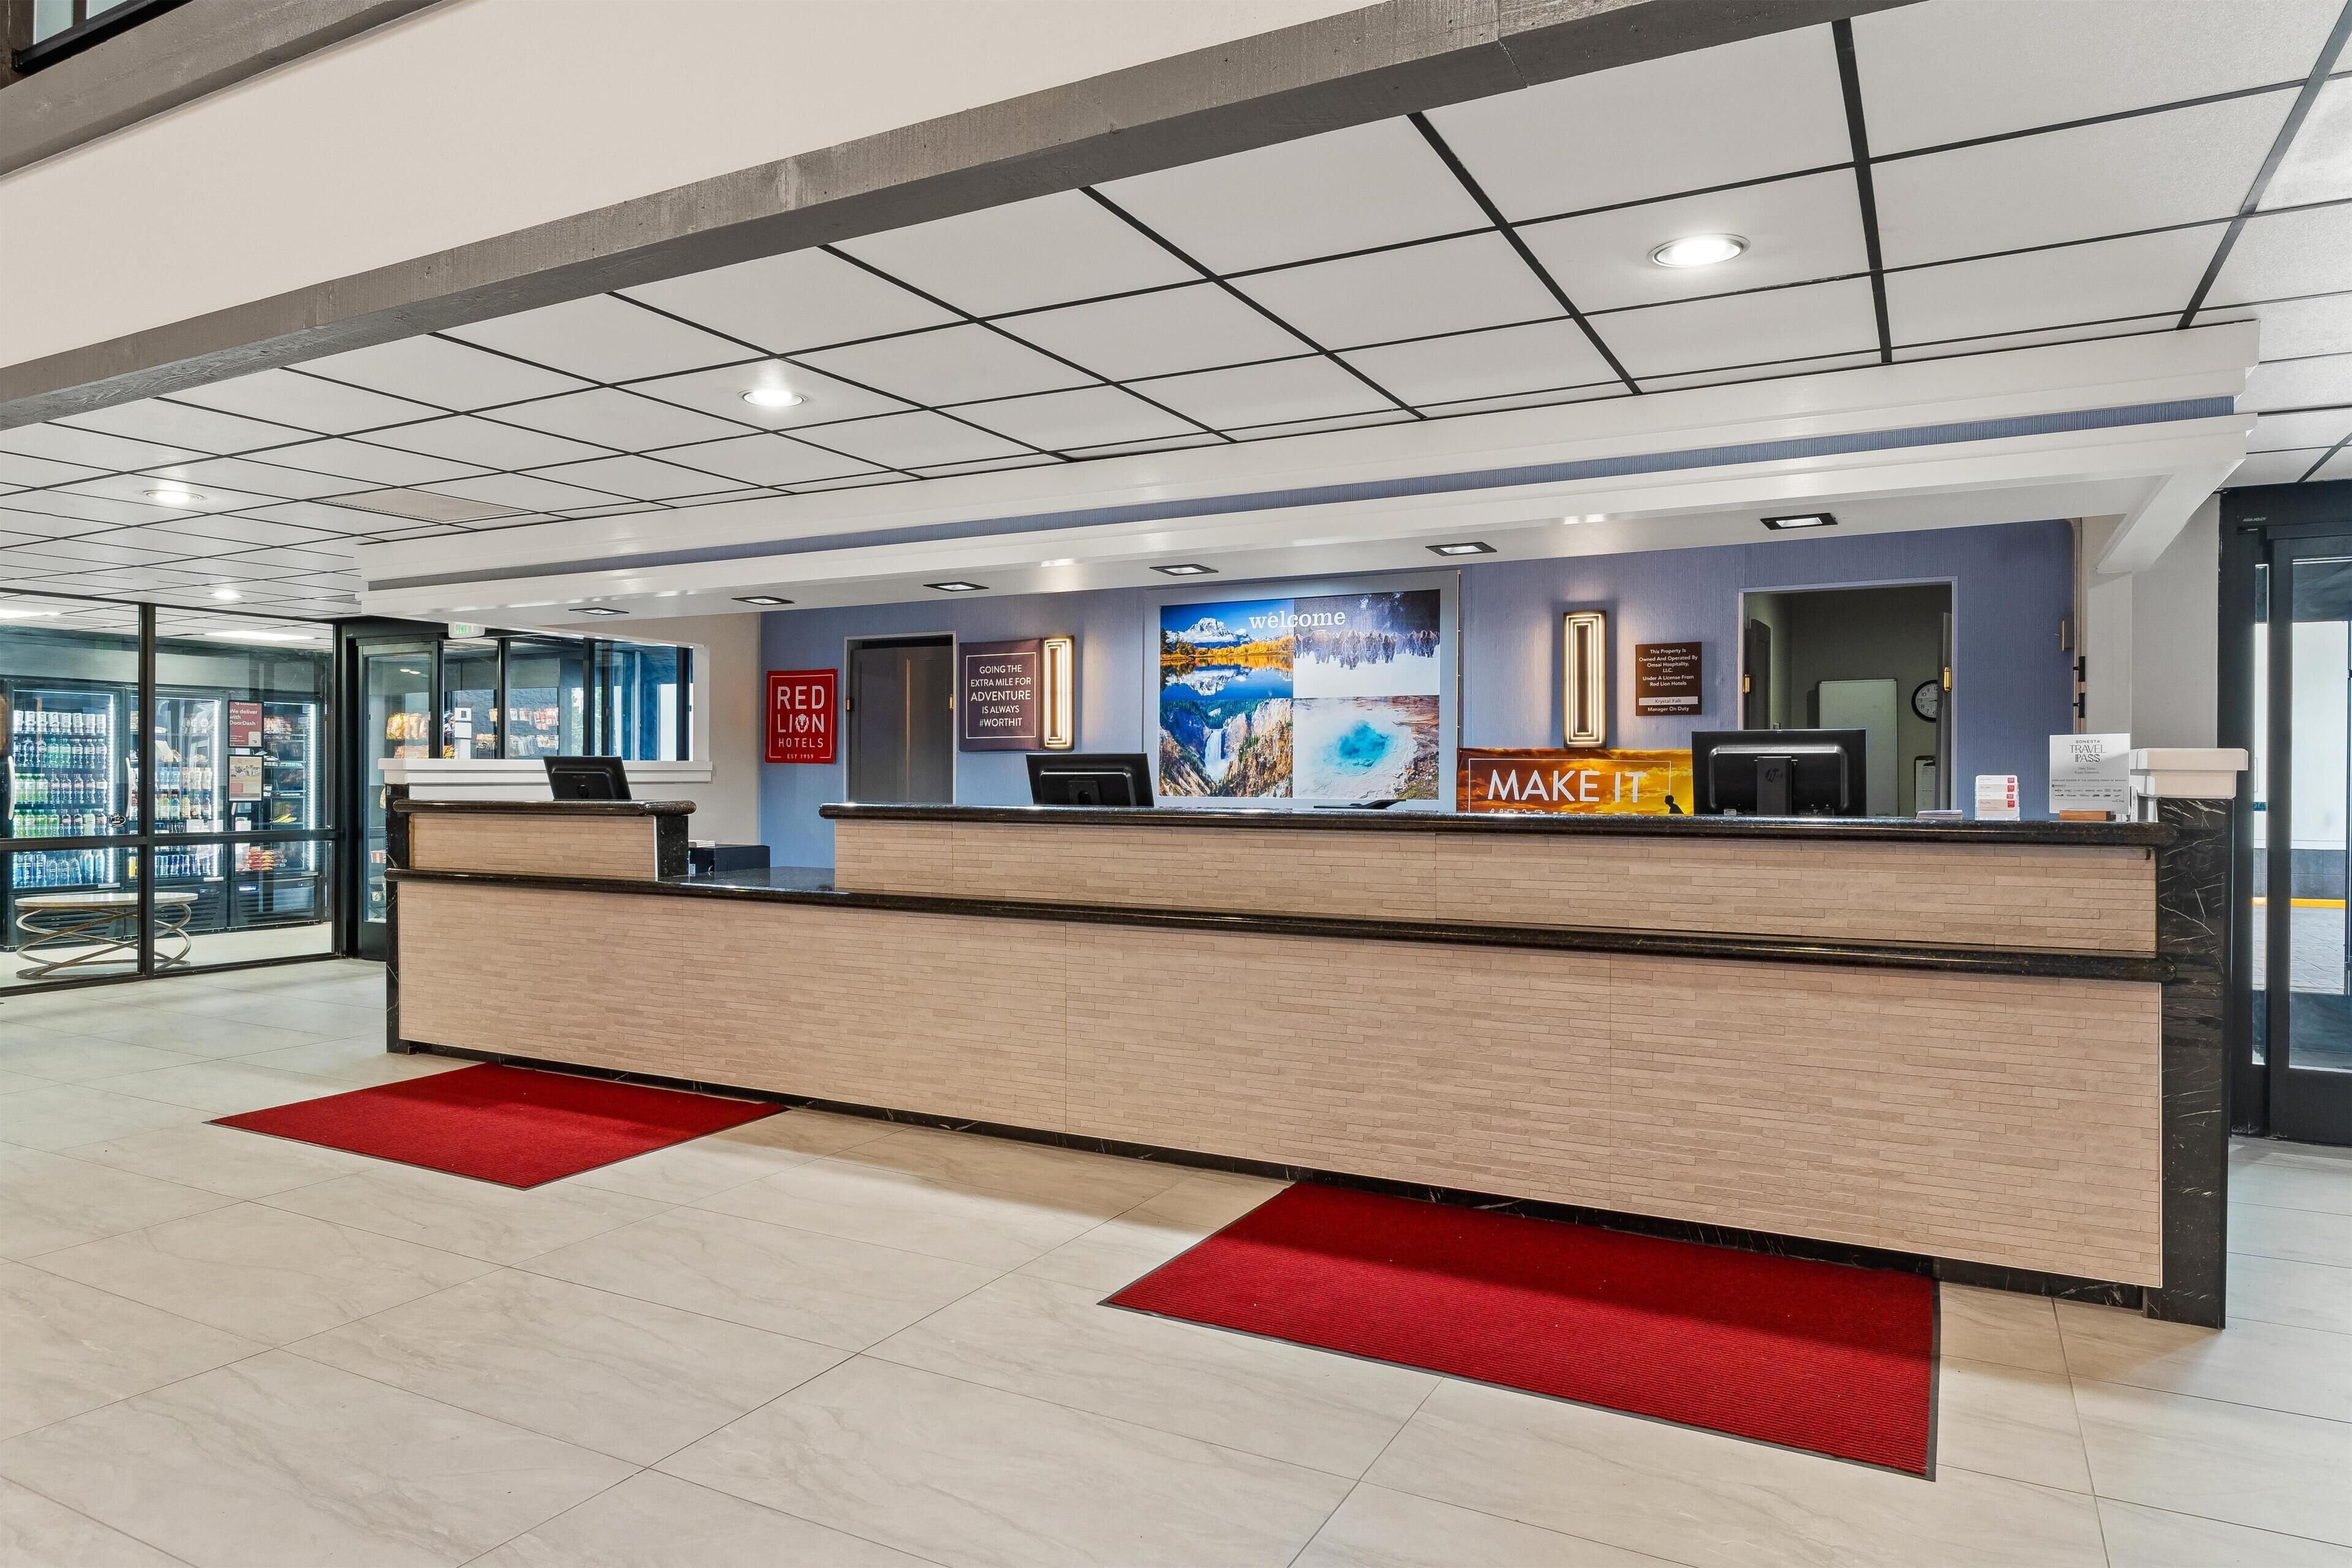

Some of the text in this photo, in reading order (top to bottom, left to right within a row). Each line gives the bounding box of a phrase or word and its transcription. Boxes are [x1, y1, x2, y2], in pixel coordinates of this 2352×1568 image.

[1249, 610, 1346, 629] welcome
[777, 686, 824, 709] RED
[971, 690, 1031, 701] ADVENTURE
[990, 705, 1019, 714] ALWAYS
[979, 718, 1022, 726] #WORTHIT
[779, 738, 823, 747] HOTELS
[2069, 744, 2107, 753] TRAVEL
[2075, 754, 2100, 763] PASS
[1487, 769, 1646, 803] MAKE IT
